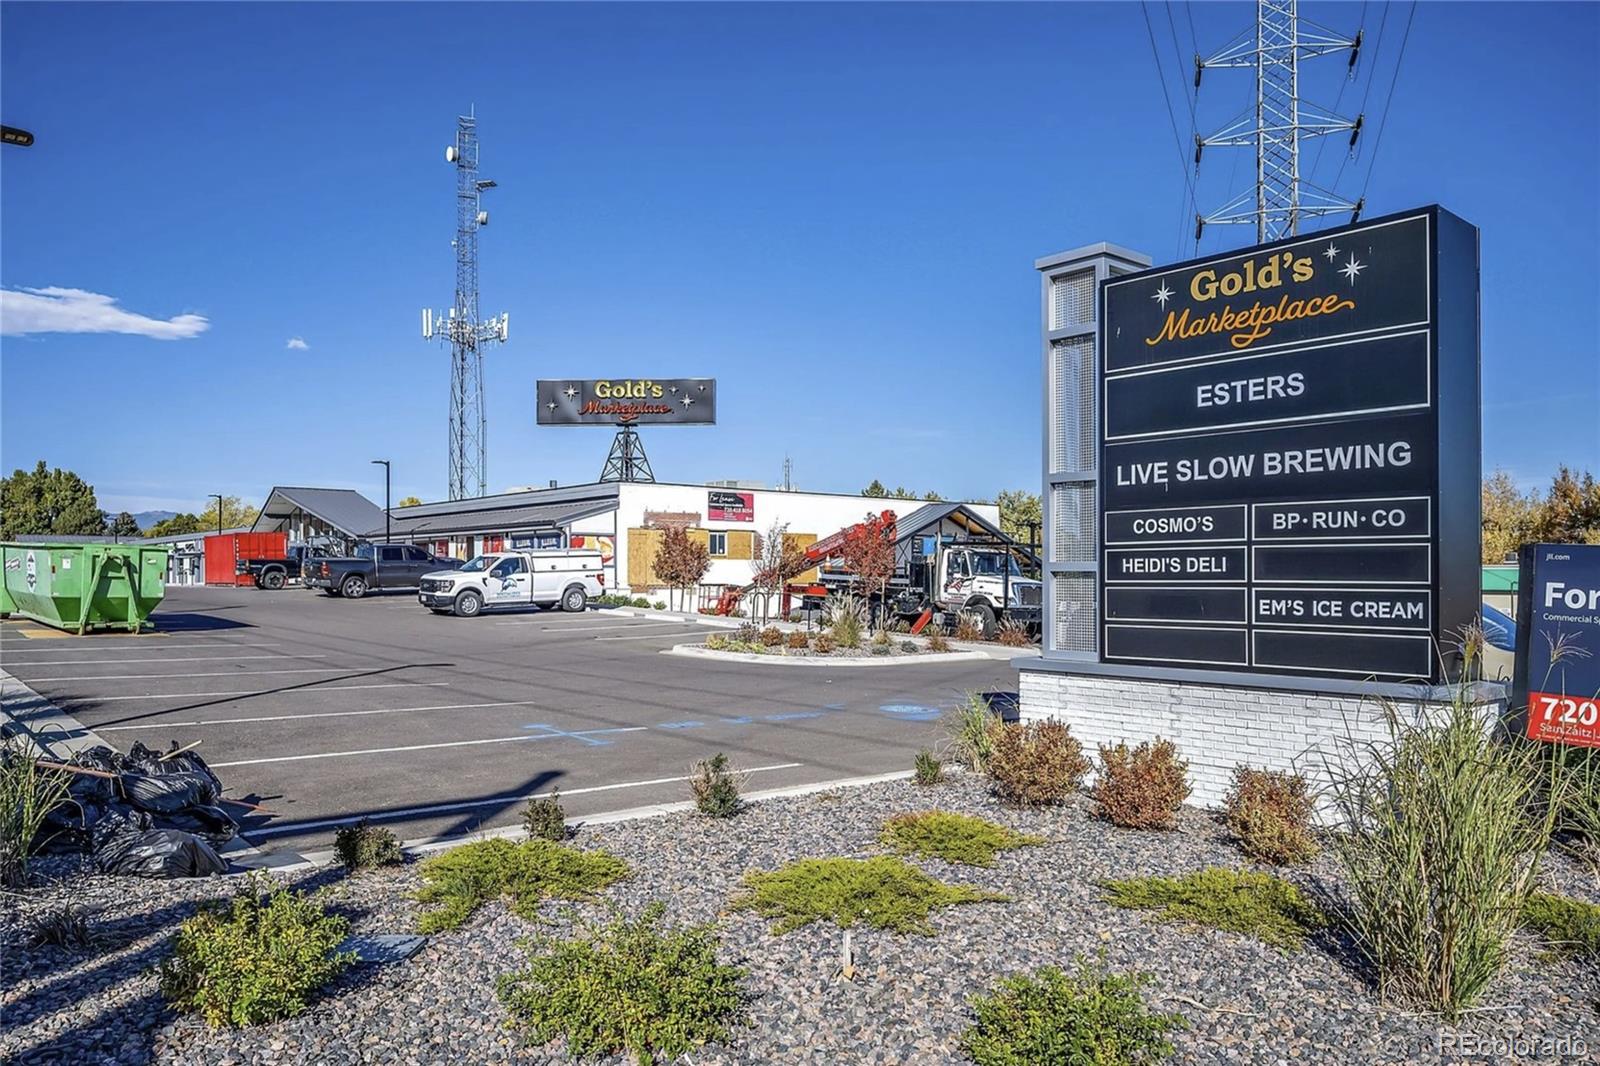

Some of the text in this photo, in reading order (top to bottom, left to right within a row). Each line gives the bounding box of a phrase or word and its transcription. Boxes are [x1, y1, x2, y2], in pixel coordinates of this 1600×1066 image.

[1190, 252, 1314, 301] Gold's
[1145, 294, 1355, 348] Marketplace
[594, 380, 664, 399] Gold's
[1197, 373, 1305, 407] ESTERS
[579, 400, 674, 421] Marketplace
[1117, 441, 1412, 486] LIVE SLOW BREWING
[1133, 516, 1214, 534] COSMO'S
[1122, 556, 1226, 573] HEIDI'S DELI
[1544, 581, 1600, 610] For
[1259, 599, 1424, 619] EM'S ICE CREAM
[1543, 612, 1592, 624] Commercial
[1540, 697, 1598, 726] 720
